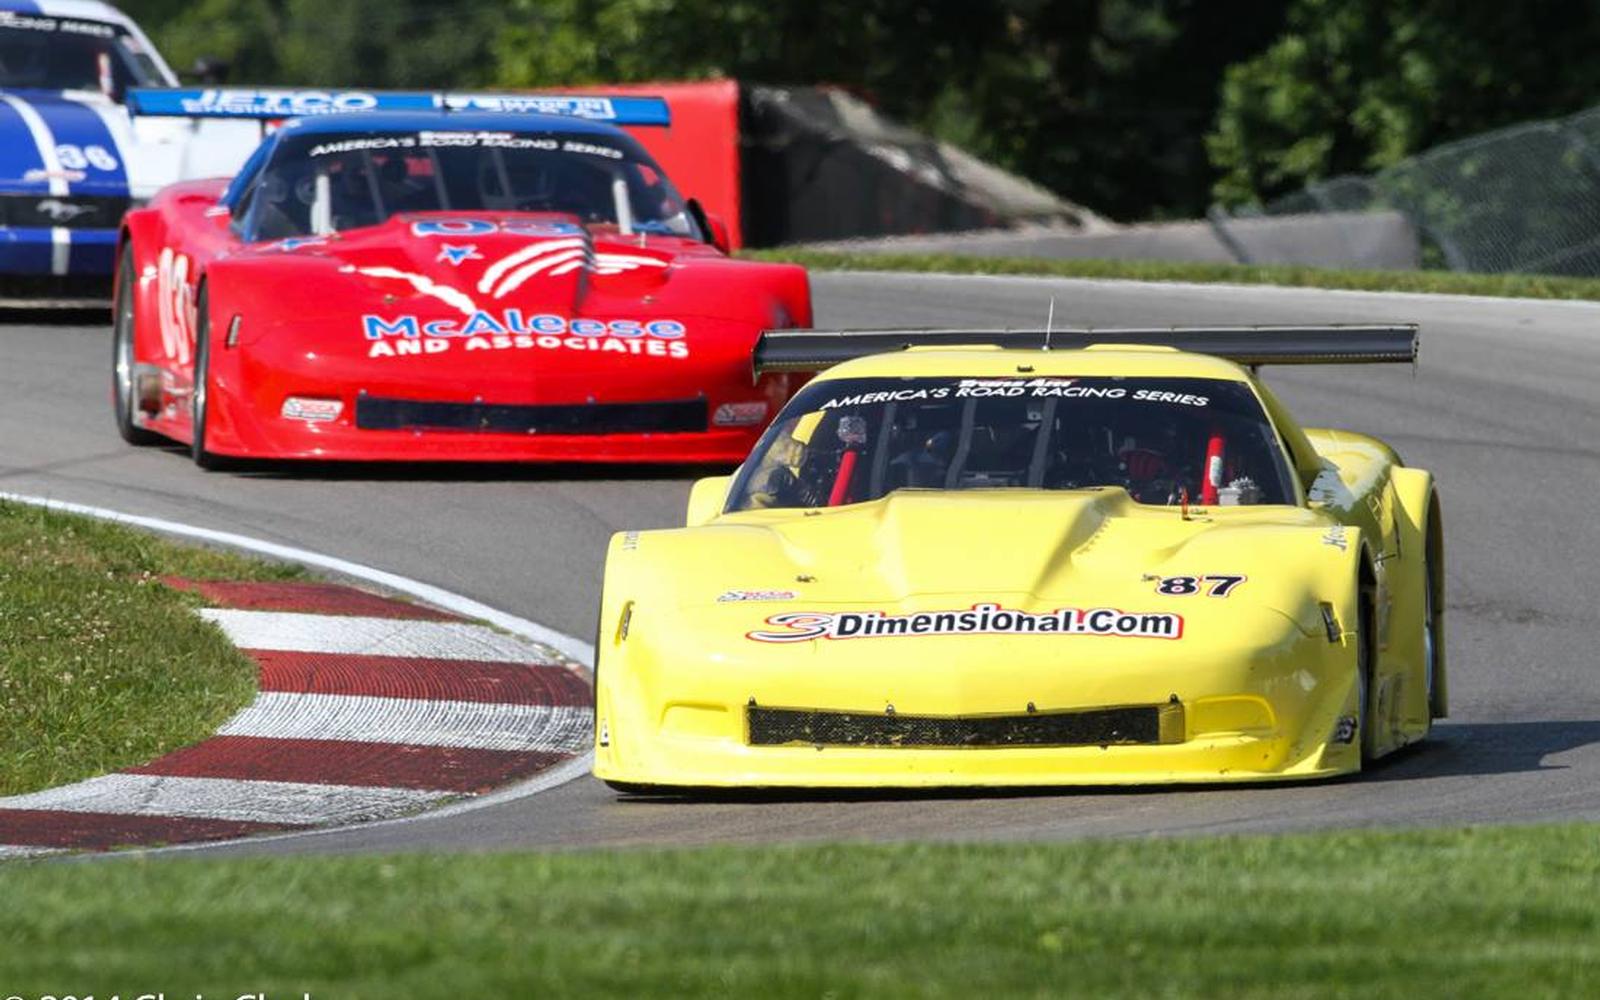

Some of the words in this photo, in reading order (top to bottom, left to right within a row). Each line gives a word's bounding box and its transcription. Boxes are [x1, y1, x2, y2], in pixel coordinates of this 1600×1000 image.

[182, 90, 379, 110] JETCO
[309, 137, 415, 157] AMERICA'S
[419, 137, 478, 147] ROAD
[482, 138, 558, 150] RACING
[562, 141, 624, 159] SERIES
[362, 308, 687, 340] McAleese
[368, 338, 450, 358] AND
[465, 336, 690, 359] ASSOCIATES
[819, 388, 951, 411] AMERICA'S
[955, 386, 1025, 398] ROAD
[1031, 387, 1128, 399] RACING
[1132, 389, 1210, 407] SERIES
[1158, 575, 1244, 597] 87
